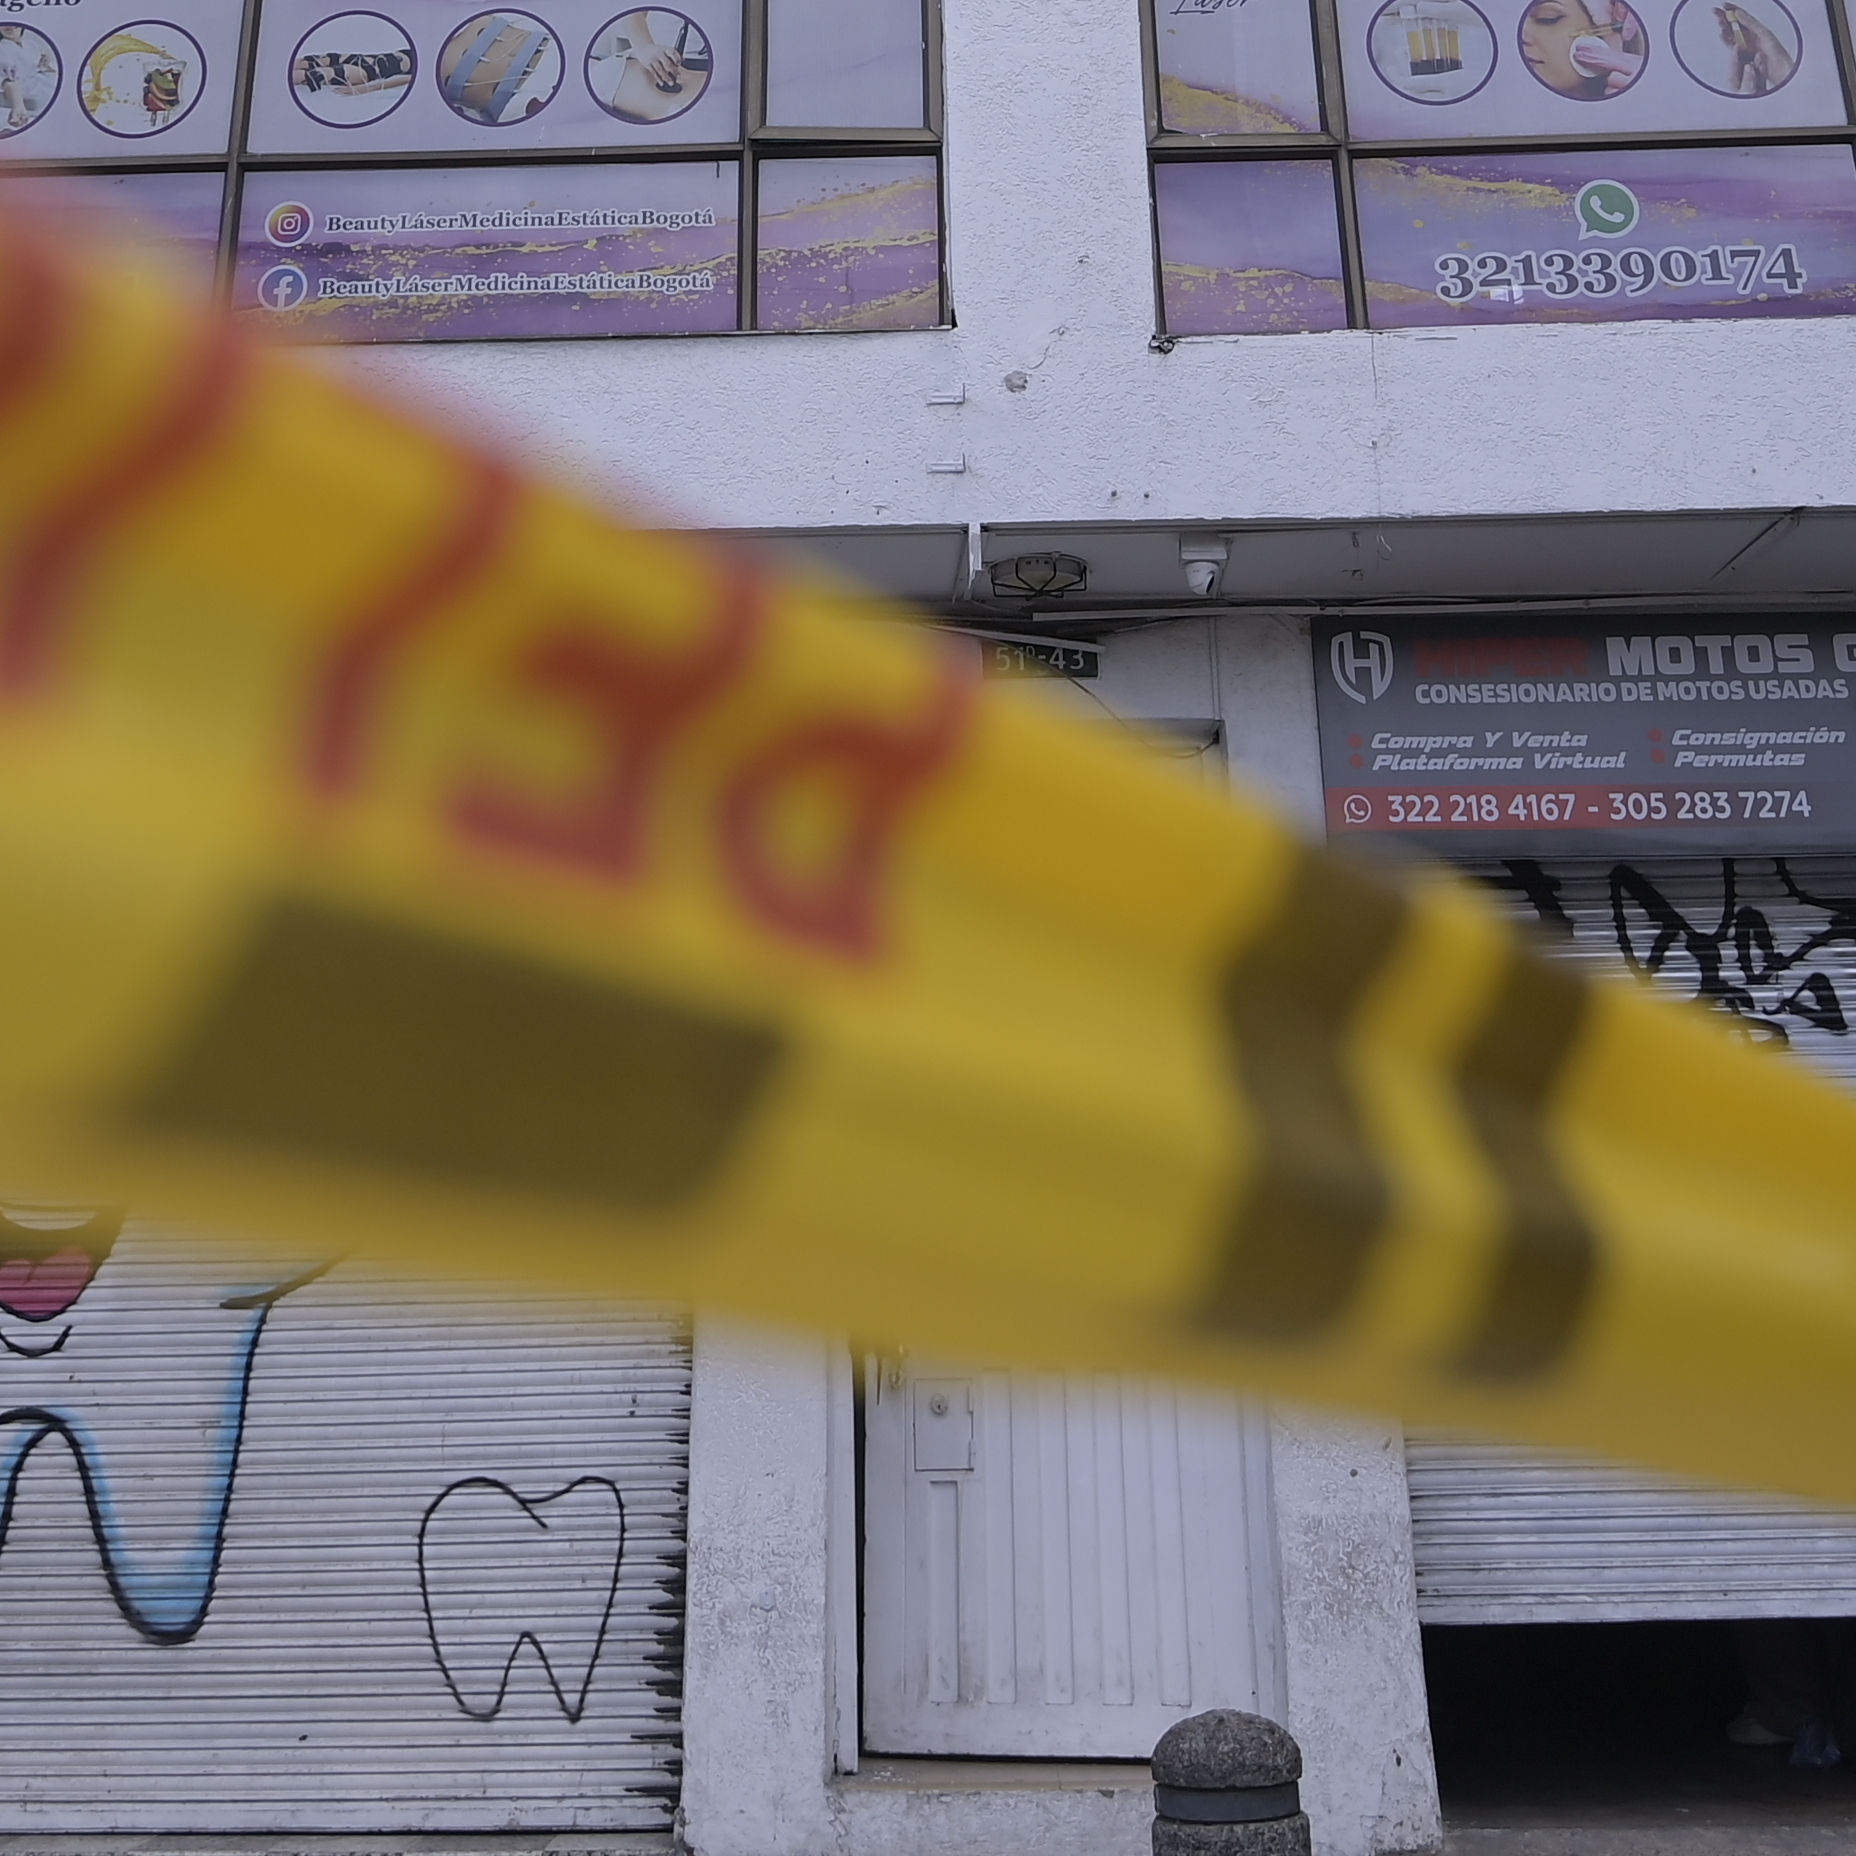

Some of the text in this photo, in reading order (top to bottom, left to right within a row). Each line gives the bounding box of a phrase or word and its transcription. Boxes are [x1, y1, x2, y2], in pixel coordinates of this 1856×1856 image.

[327, 208, 713, 234] BeautyLáserMedicinaEstáticaBogotá
[321, 272, 711, 298] BeautyLáserMedicinaEstáticaBogotá
[1439, 246, 1804, 298] 3213390174
[1415, 638, 1587, 677] HIPER
[1607, 634, 1813, 675] MOTOS
[1415, 678, 1848, 704] CONSESIONARIO DE MOTOS USADAS
[1372, 731, 1586, 751] Compra Y Venta
[1672, 726, 1845, 749] Consignación
[1372, 751, 1625, 771] Plataforma Virtual
[1674, 749, 1804, 767] Permutas
[1389, 790, 1810, 822] 322 218 4167 305 283 7274
